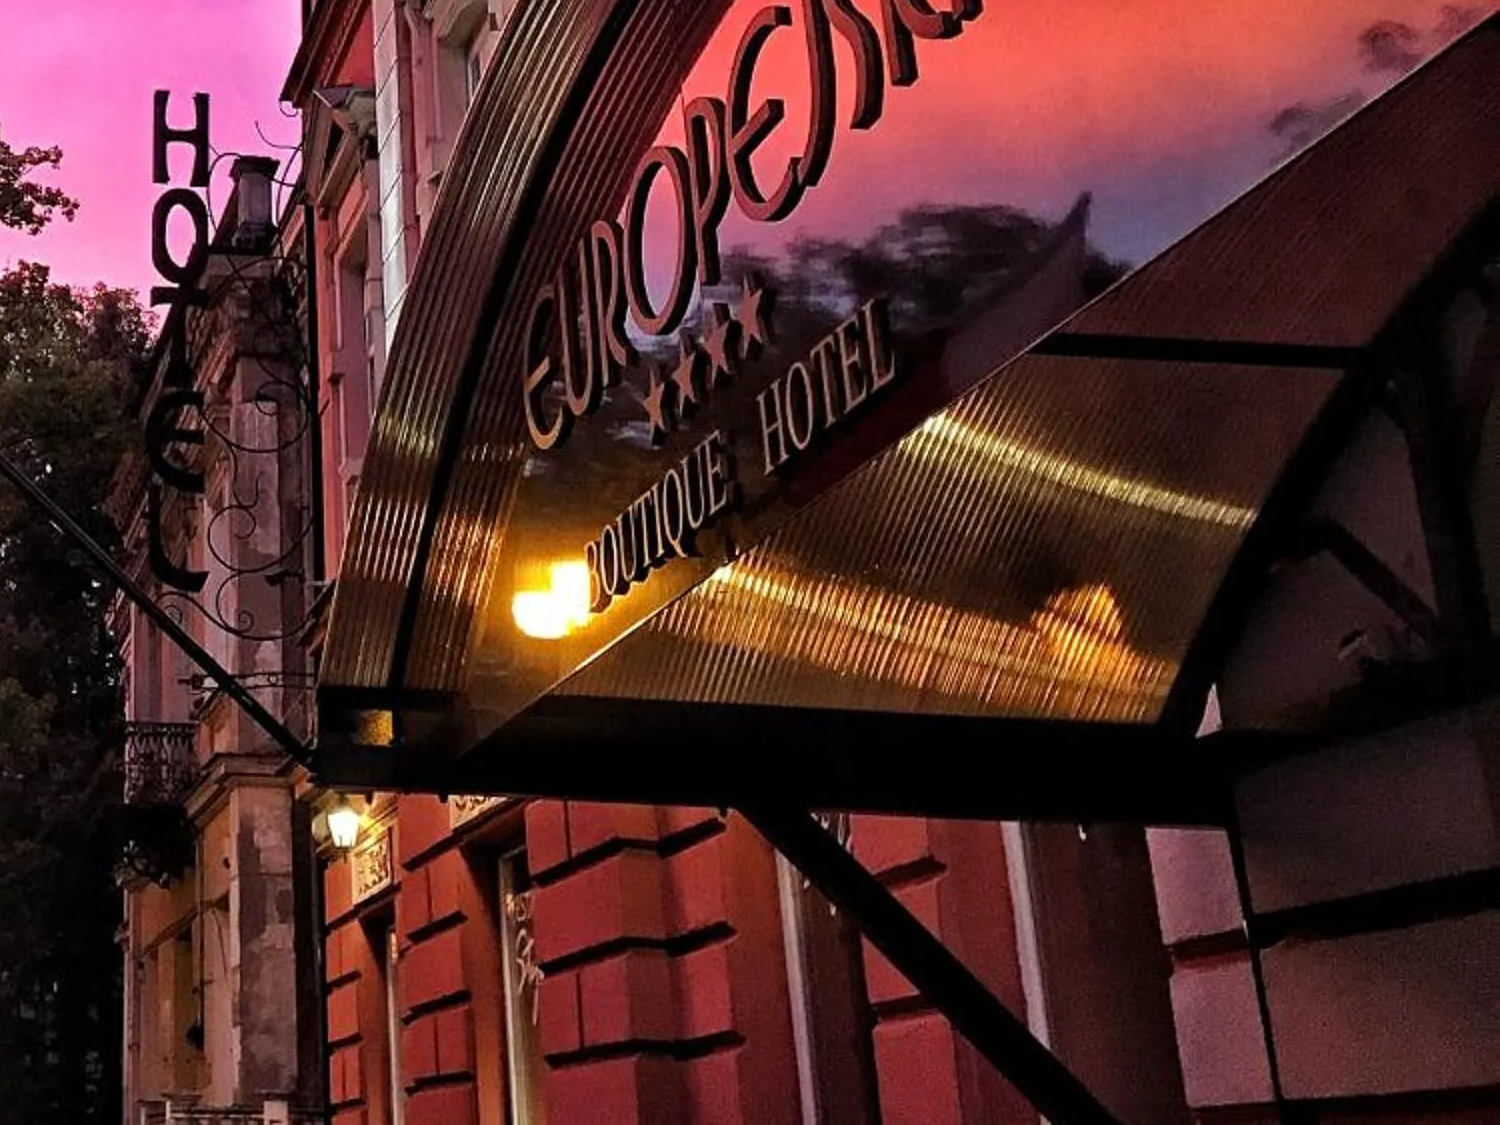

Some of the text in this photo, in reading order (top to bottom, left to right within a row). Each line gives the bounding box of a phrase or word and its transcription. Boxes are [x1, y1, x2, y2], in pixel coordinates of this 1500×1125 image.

[146, 89, 211, 593] HOTEL
[583, 297, 896, 611] BOUTIQUE HOTEL
